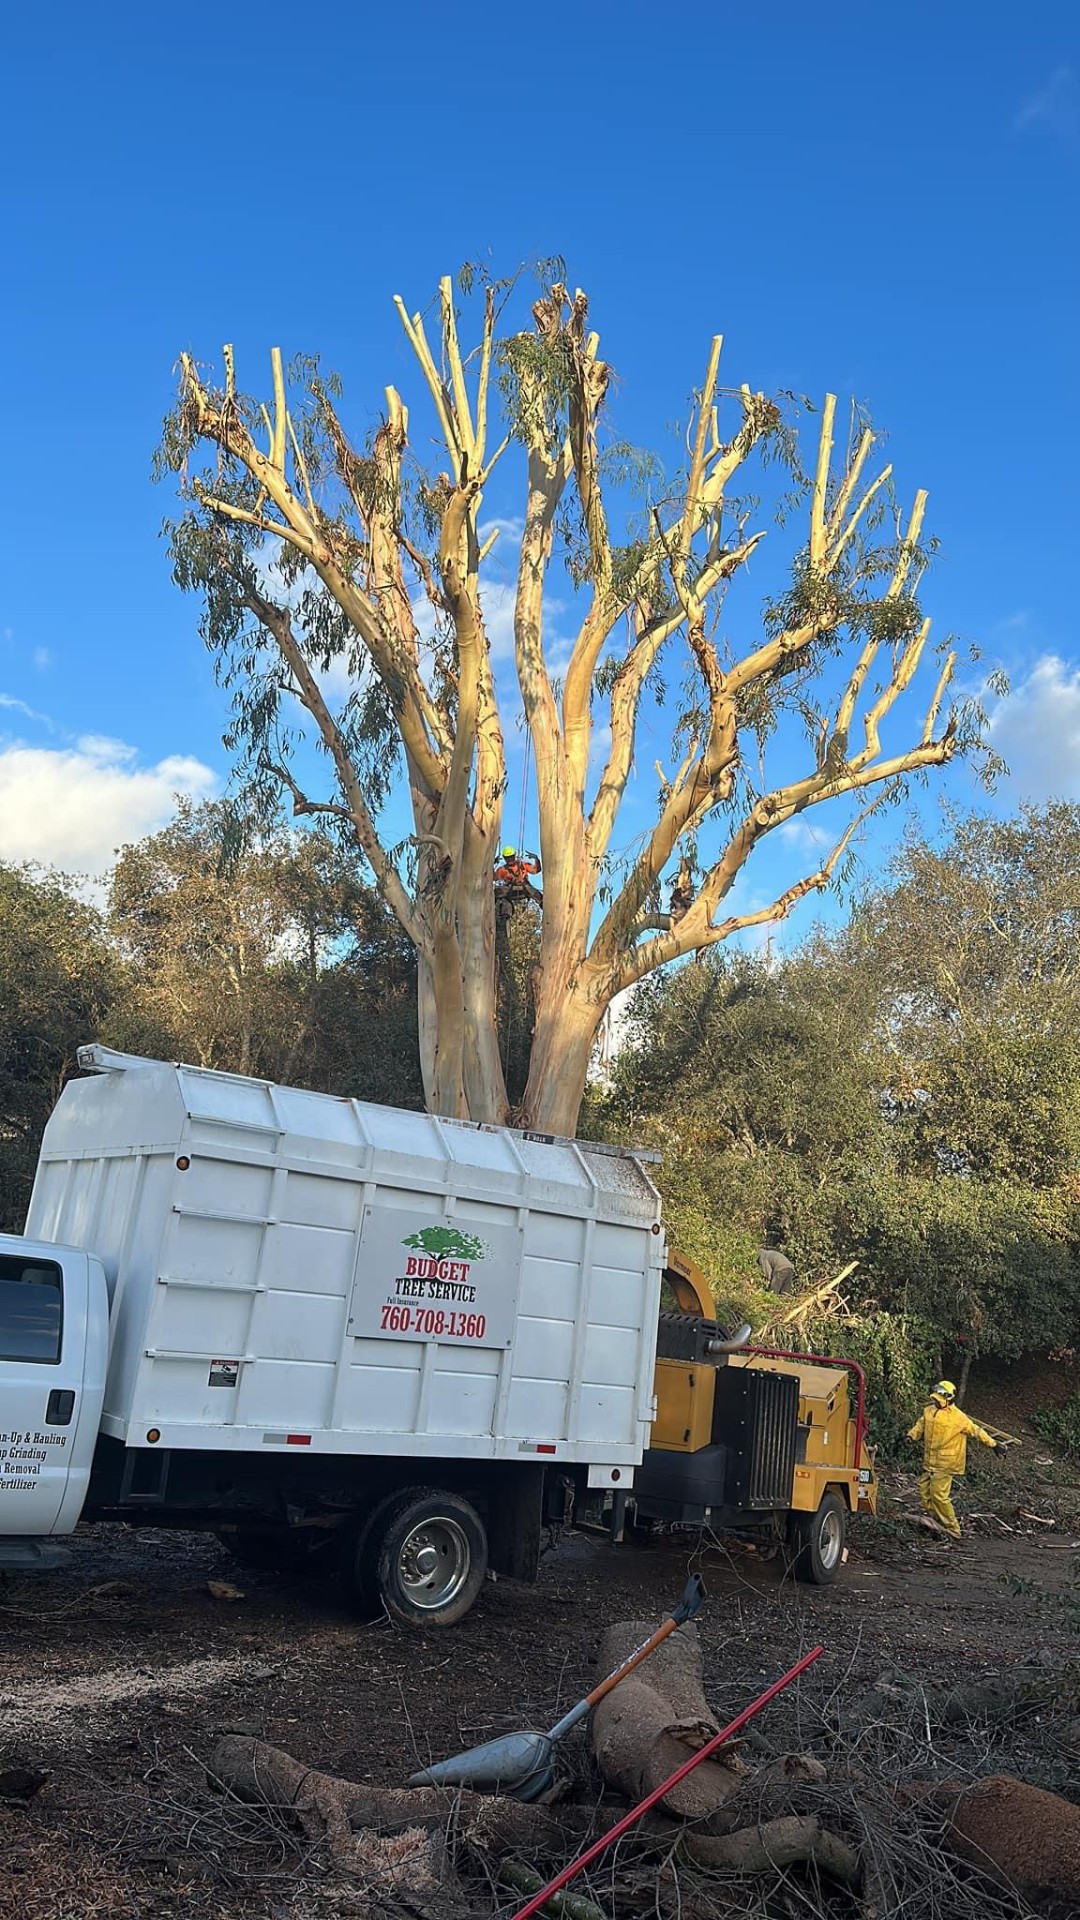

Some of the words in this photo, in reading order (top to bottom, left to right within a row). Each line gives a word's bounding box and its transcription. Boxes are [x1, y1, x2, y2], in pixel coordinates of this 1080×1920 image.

[405, 1257, 470, 1282] BUDGET
[395, 1278, 425, 1297] TREE
[427, 1281, 476, 1303] SERVICE
[380, 1305, 486, 1338] 760-708-1360
[0, 1431, 22, 1446] n-Up
[24, 1432, 31, 1443] &
[32, 1432, 67, 1448] Hauling
[0, 1449, 7, 1460] p
[9, 1447, 47, 1462] Grinding
[4, 1462, 41, 1474] Removal
